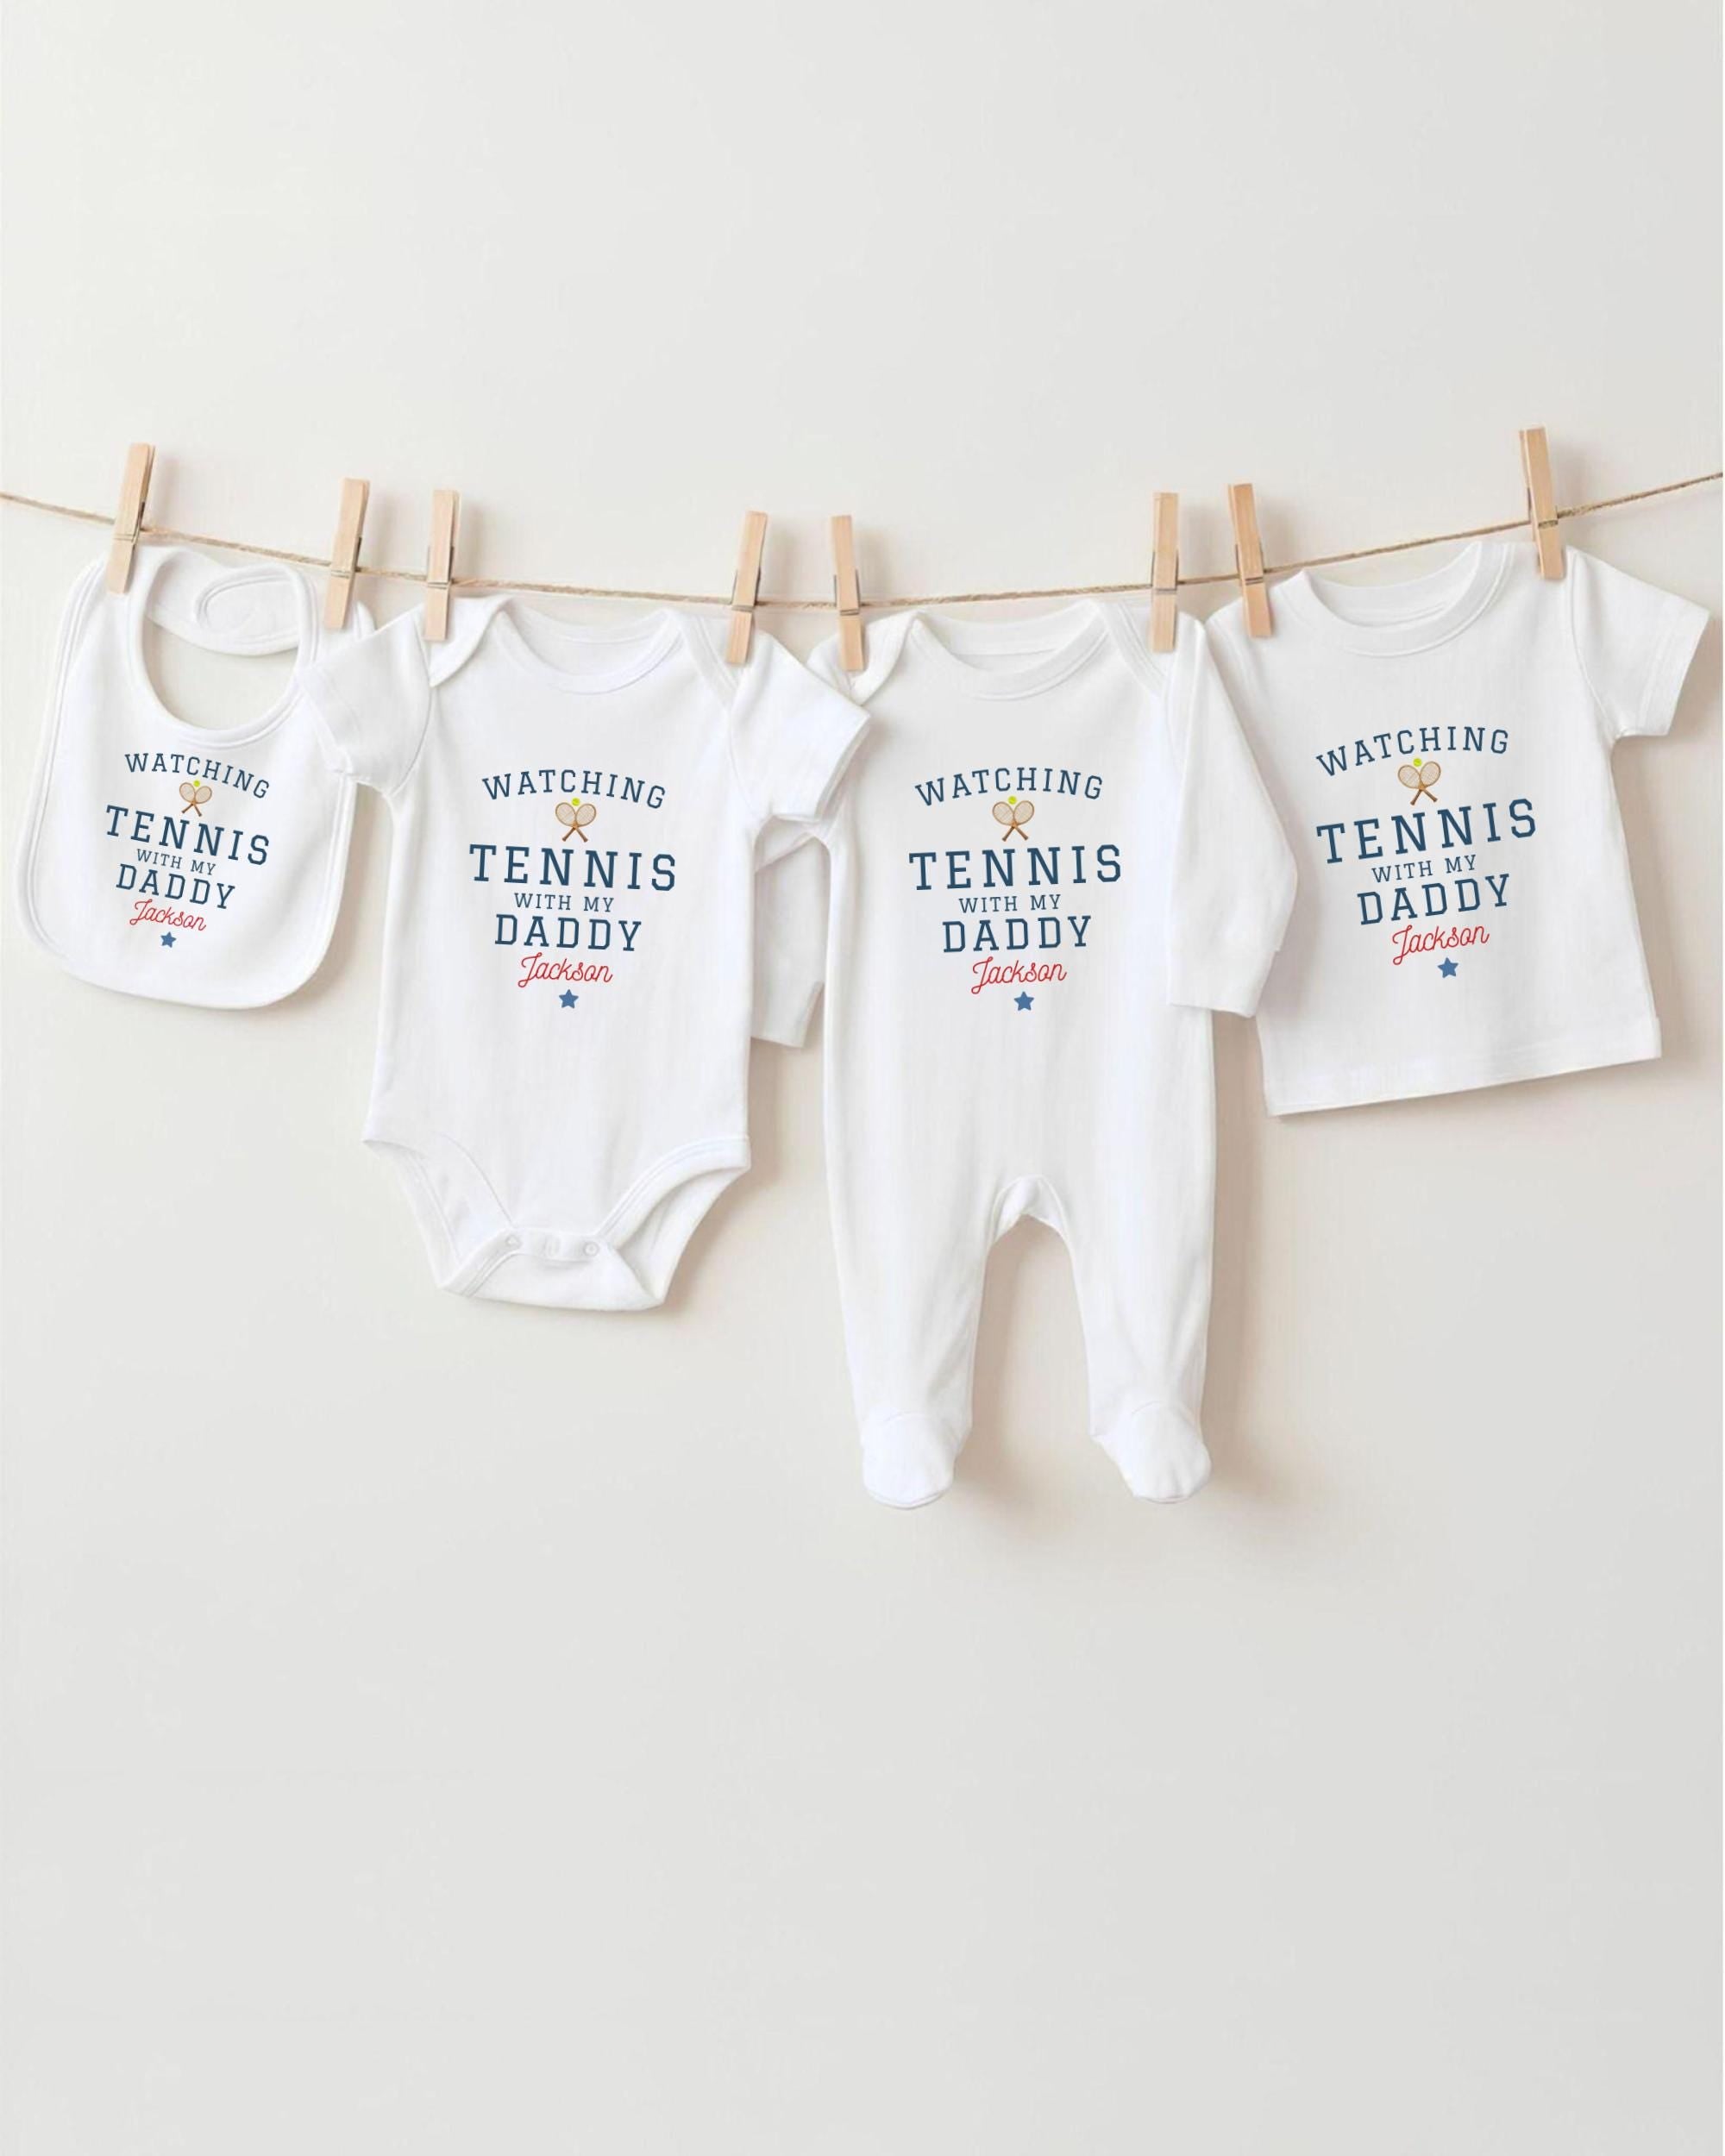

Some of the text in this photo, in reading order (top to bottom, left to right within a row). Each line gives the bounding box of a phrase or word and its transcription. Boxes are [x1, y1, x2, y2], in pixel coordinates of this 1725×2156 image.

[1316, 726, 1510, 777] WATCHING
[124, 753, 271, 799] WATCHING
[481, 768, 666, 809] WATCHING
[915, 767, 1104, 806] WATCHING
[105, 804, 271, 866] TENNIS
[1316, 798, 1537, 864] TENNIS
[136, 848, 216, 876] WITH MY
[469, 843, 676, 892] TENNIS
[908, 843, 1121, 891] TENNIS
[1371, 855, 1477, 884] WITH MY
[116, 862, 235, 910] DADDY
[514, 892, 615, 912] WITH MY
[959, 893, 1062, 913] WITH MY
[1357, 873, 1510, 925] DADDY
[129, 899, 207, 932] Jackson
[494, 912, 643, 952] DADDY
[942, 915, 1092, 953] DADDY
[1391, 924, 1490, 966] Jackson
[518, 951, 613, 989] Jackson
[970, 956, 1068, 995] Jackson
